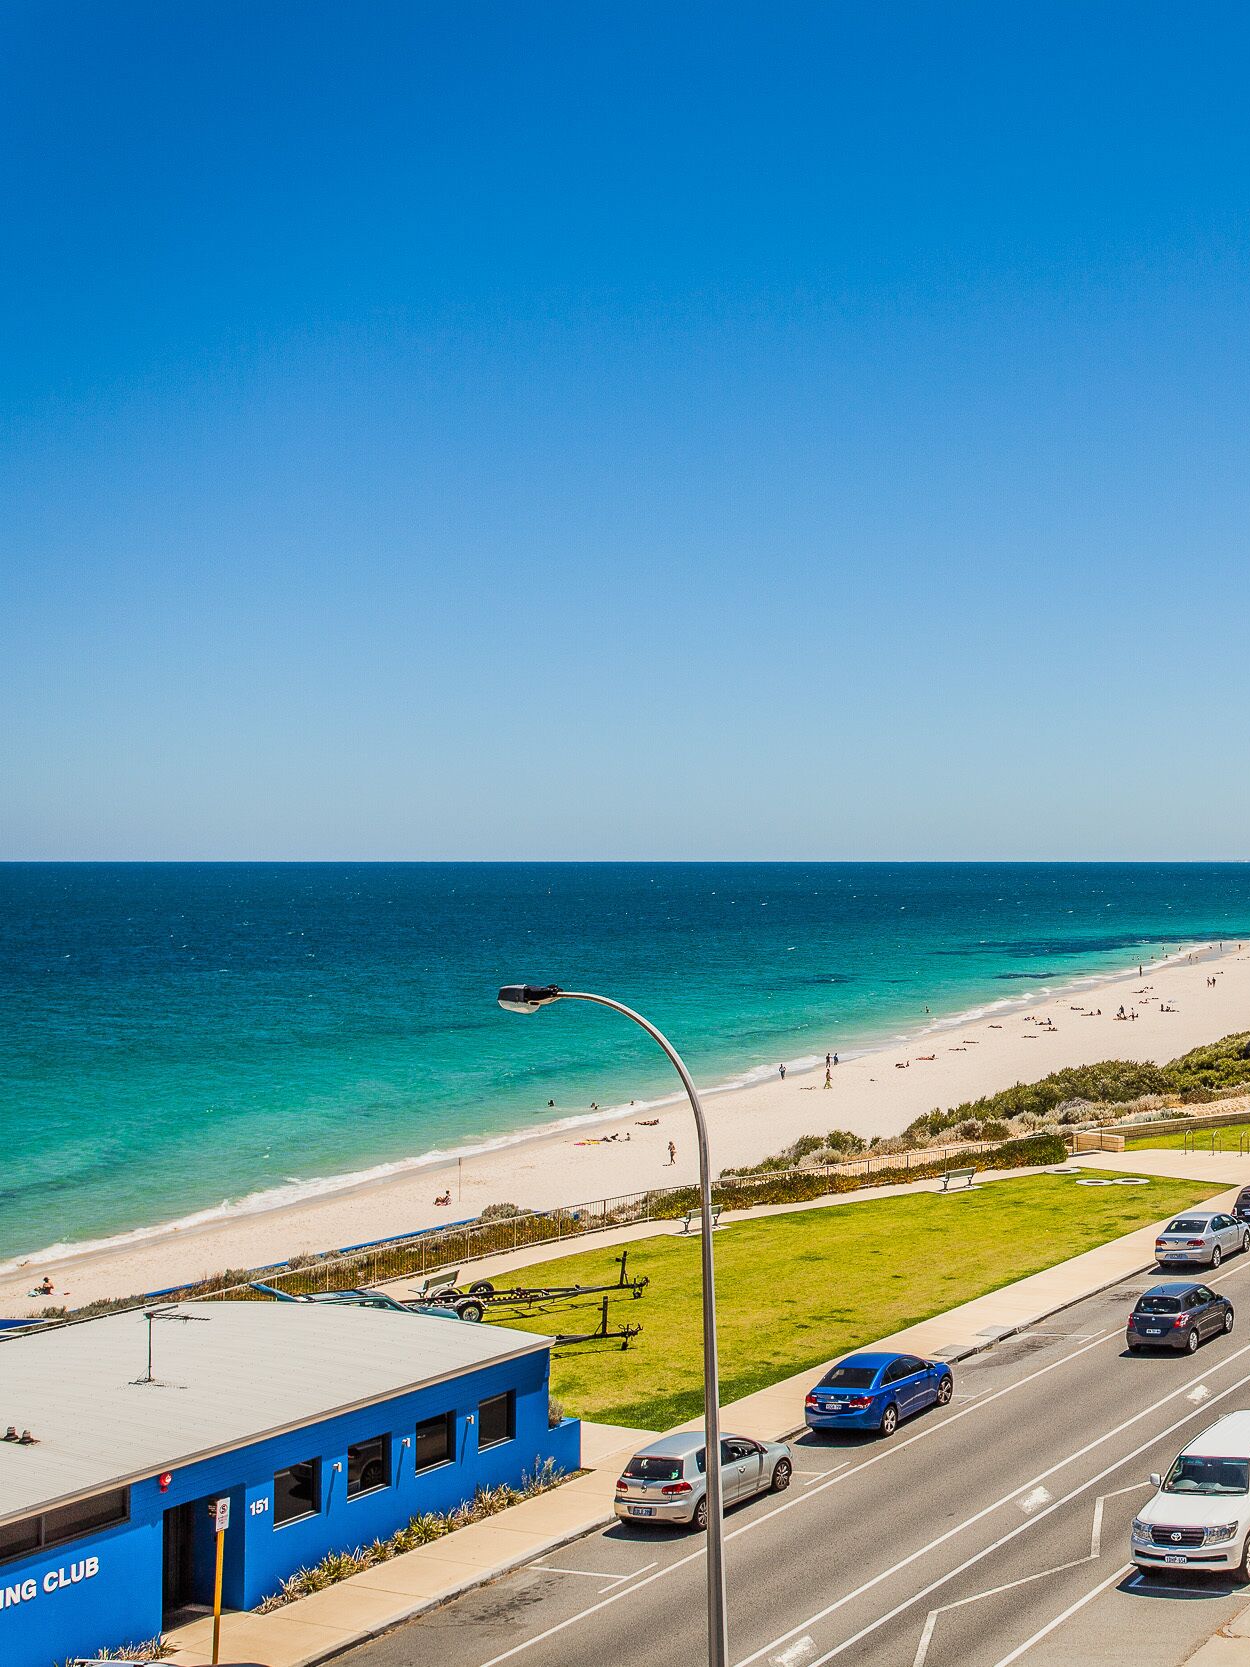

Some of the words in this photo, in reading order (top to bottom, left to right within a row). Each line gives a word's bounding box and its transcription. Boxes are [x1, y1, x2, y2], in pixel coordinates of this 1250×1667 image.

[250, 1497, 269, 1516] 151
[0, 1579, 37, 1610] ING
[43, 1556, 99, 1593] CLUB
